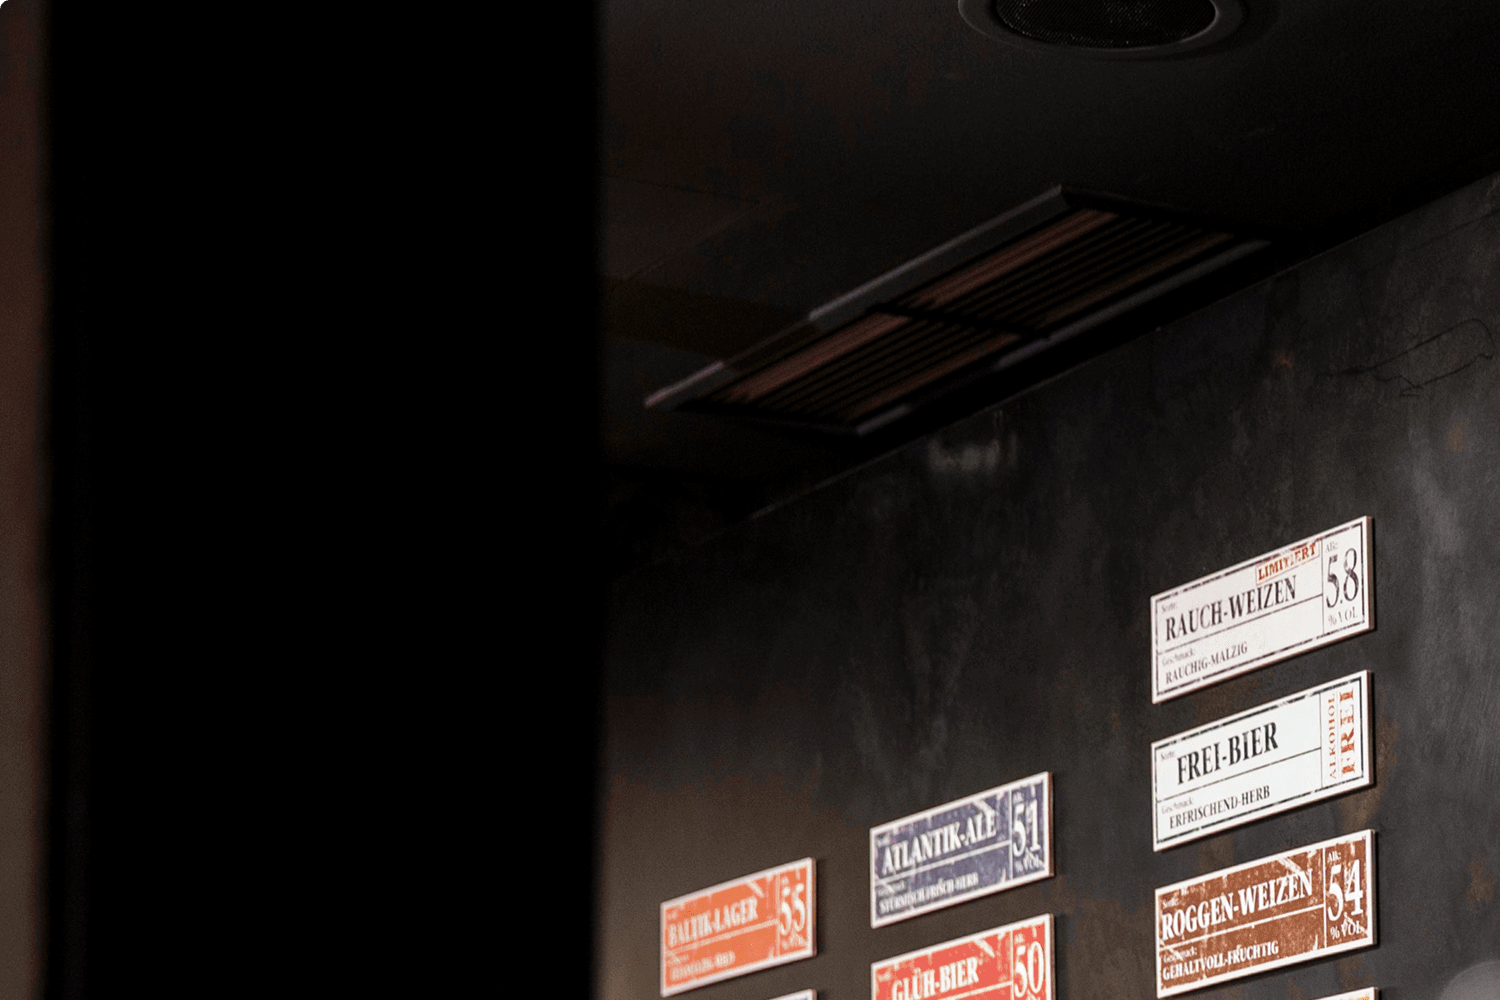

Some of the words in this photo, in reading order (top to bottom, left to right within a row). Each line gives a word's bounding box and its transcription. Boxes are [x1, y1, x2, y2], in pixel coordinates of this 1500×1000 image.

[1165, 574, 1297, 642] RAUCH-WEIZEN
[1326, 547, 1360, 609] 5.8
[1165, 641, 1248, 685] RAUCHIG-MALZIG
[1177, 721, 1279, 785] FREI-BIER
[1169, 785, 1270, 829] ERFRISCHEND-HERB
[882, 810, 997, 875] ATLANTIK-ALE
[1162, 869, 1313, 941] ROGGEN-WEIZEN
